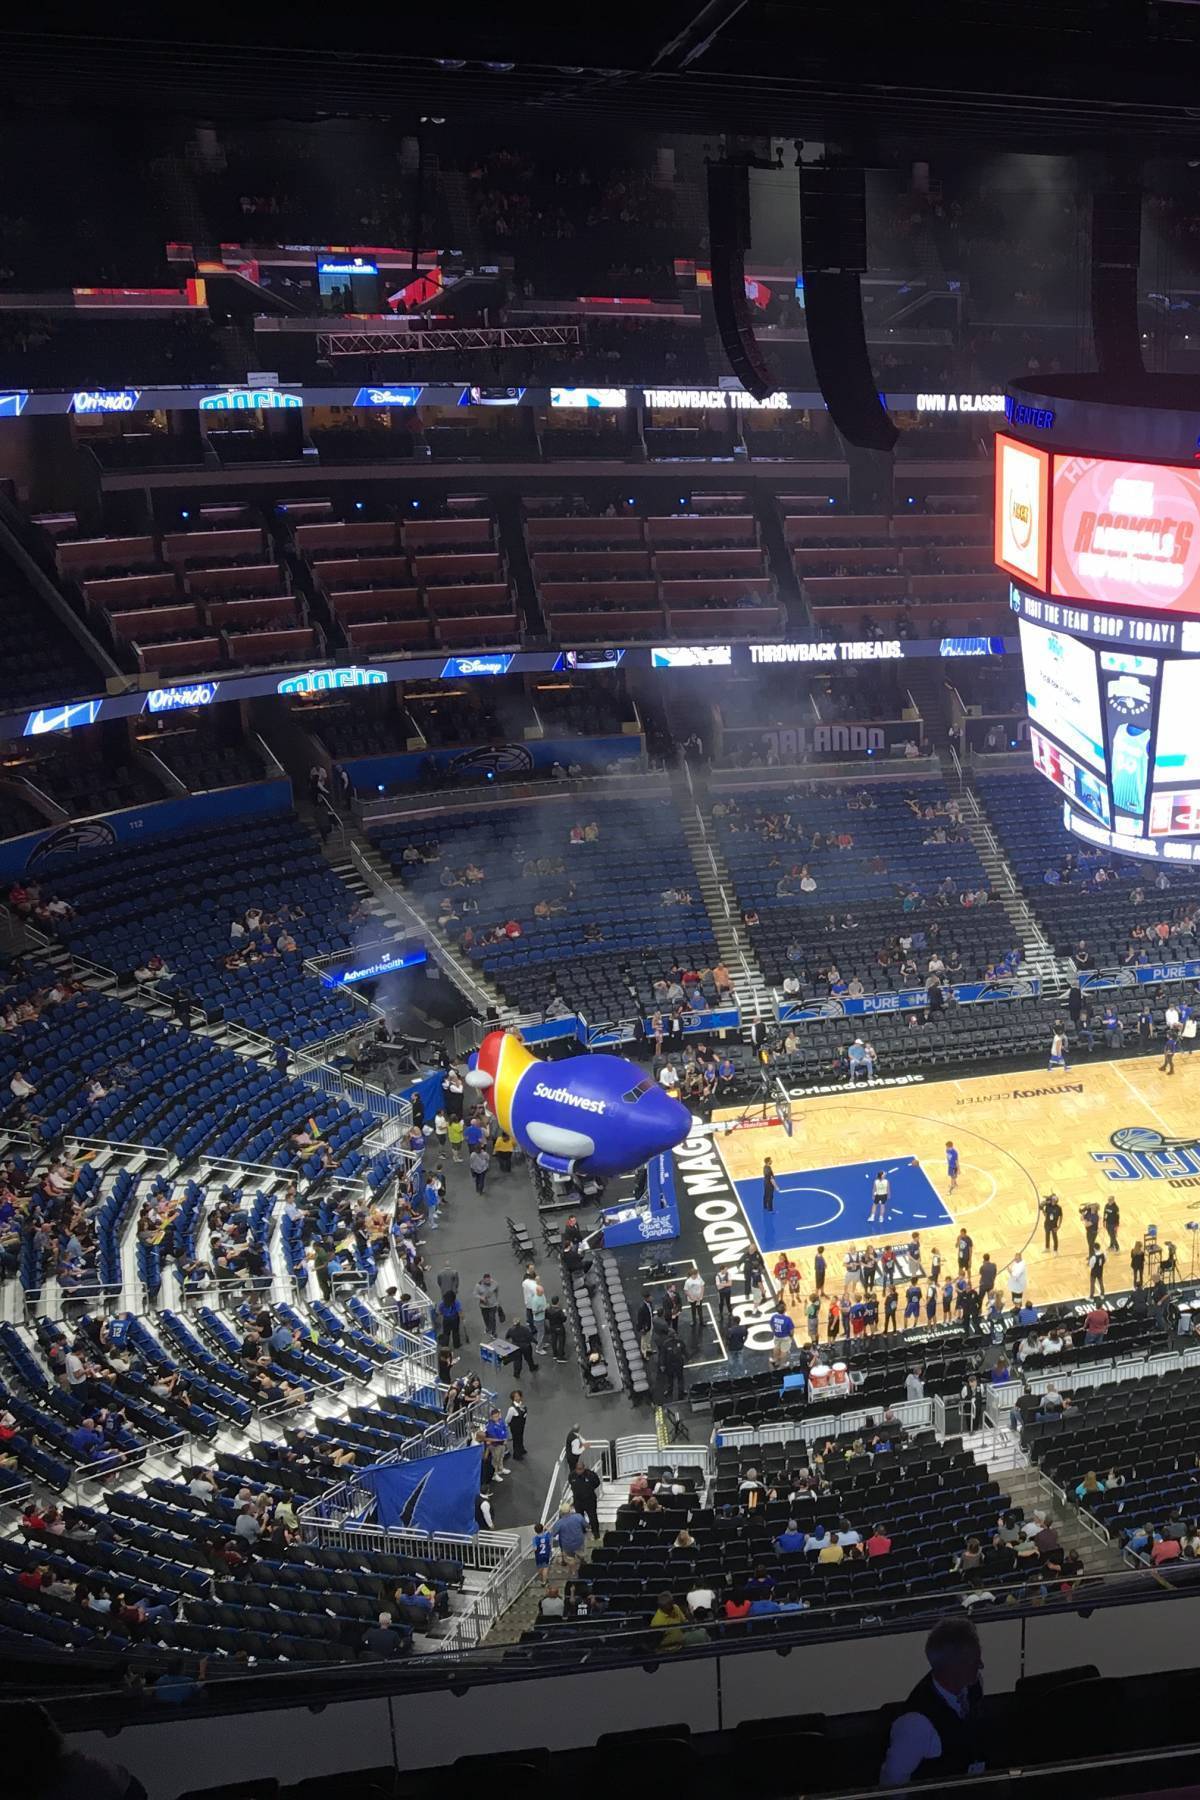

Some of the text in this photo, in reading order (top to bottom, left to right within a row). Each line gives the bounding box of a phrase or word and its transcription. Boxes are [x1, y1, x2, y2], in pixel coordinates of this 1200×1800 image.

[366, 389, 411, 407] Disney
[643, 389, 726, 409] THROWBACK
[916, 393, 1005, 413] OWN A CLASSI
[1014, 405, 1054, 428] CENTER
[1044, 604, 1060, 624] THE
[1062, 608, 1089, 631] TEAM
[1093, 616, 1124, 637] SHOP
[1129, 620, 1175, 643] TODAY!
[749, 643, 837, 664] THROWBACK
[839, 641, 905, 661] THREADS.
[458, 658, 502, 676] Disney
[762, 725, 886, 756] ORLANDO
[129, 818, 145, 830] 112
[343, 957, 404, 982] AdventHealth
[1153, 966, 1186, 980] PURE
[863, 996, 900, 1011] PURE
[533, 1082, 607, 1116] Southwest
[1013, 1083, 1085, 1101] Amway
[539, 1543, 546, 1554] 2
